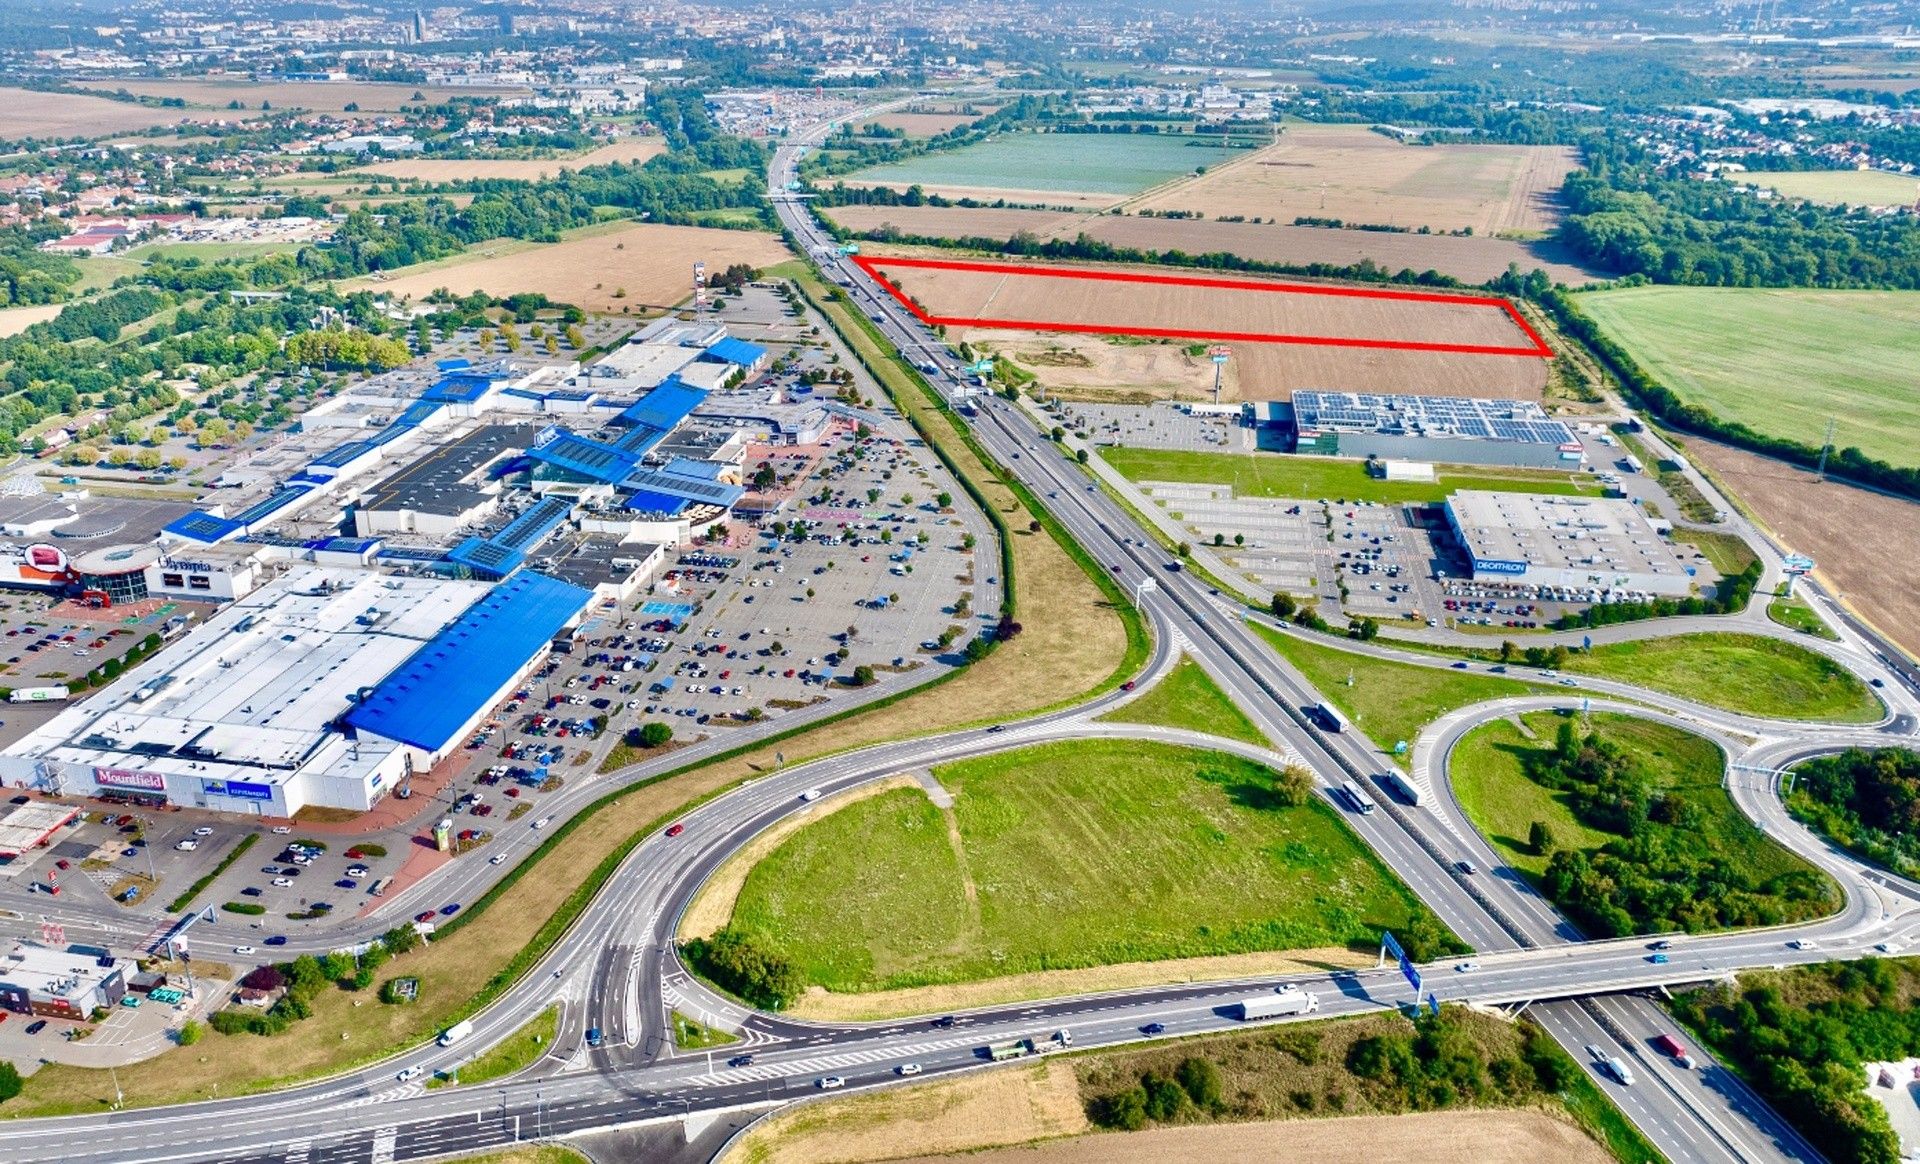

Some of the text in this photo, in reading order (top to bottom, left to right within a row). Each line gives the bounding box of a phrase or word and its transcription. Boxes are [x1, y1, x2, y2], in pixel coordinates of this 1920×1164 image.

[158, 555, 211, 573] Olympia
[1476, 561, 1525, 572] DECATHLON
[98, 770, 162, 787] Mountfield
